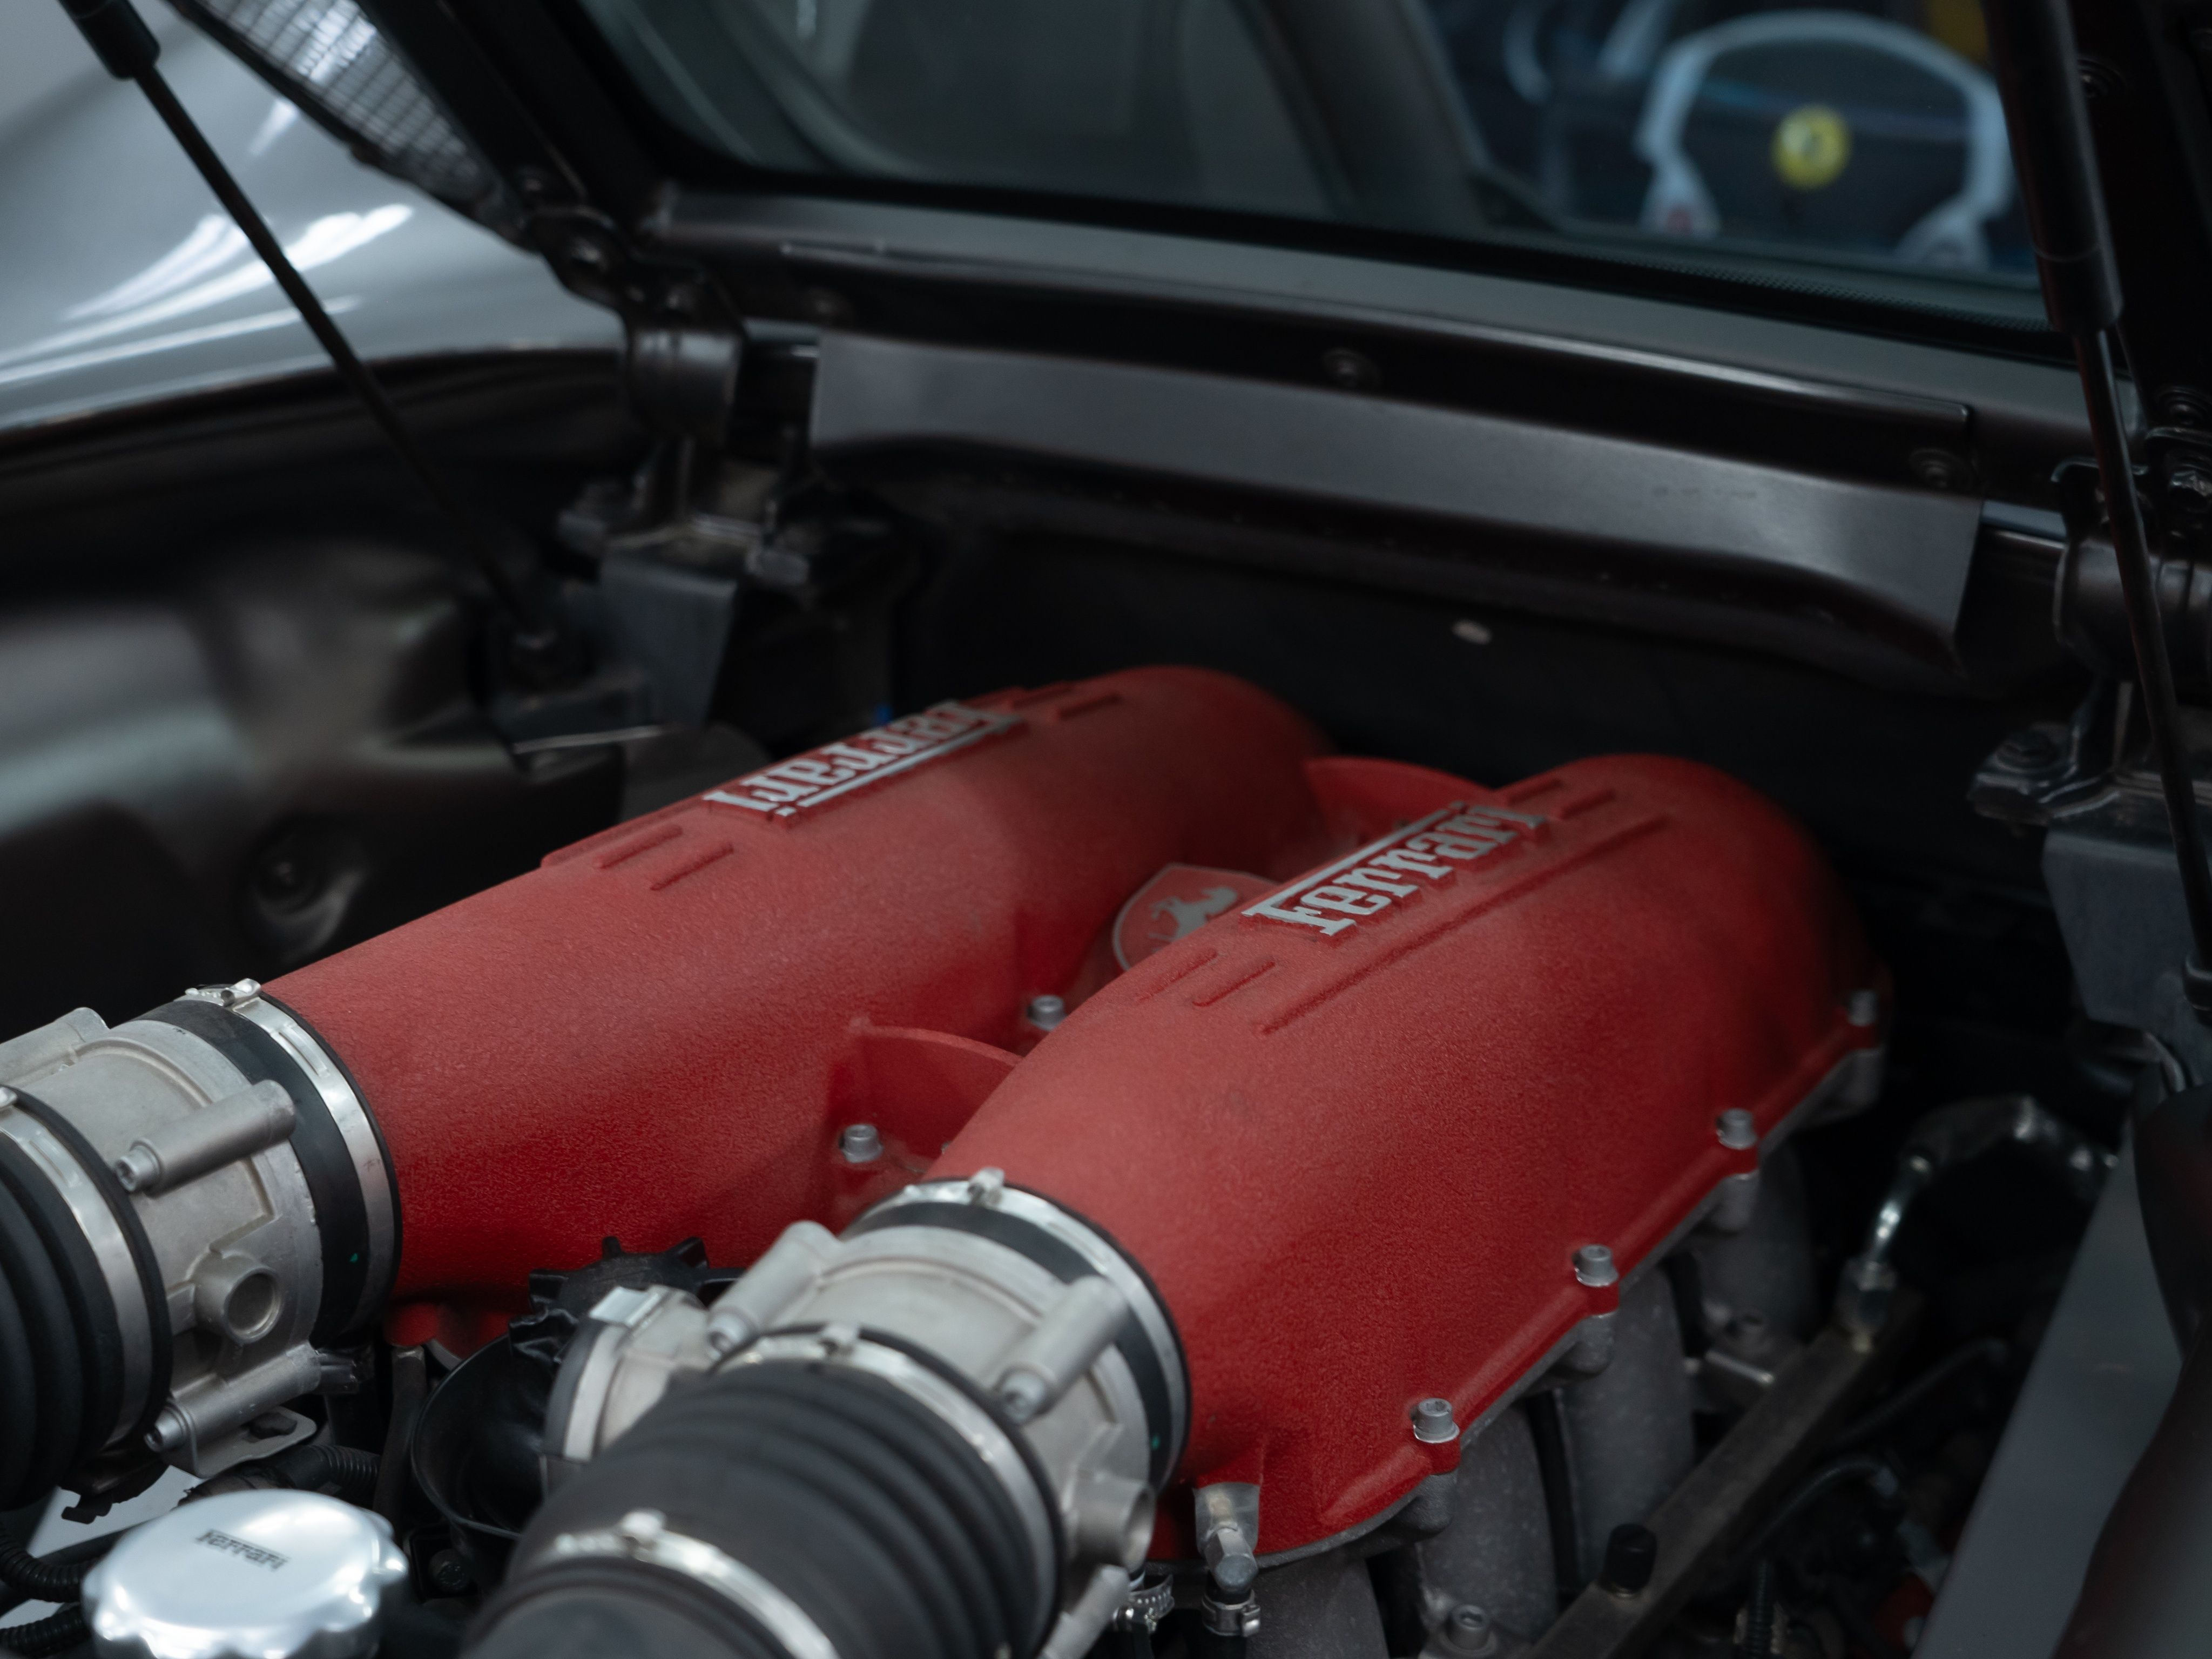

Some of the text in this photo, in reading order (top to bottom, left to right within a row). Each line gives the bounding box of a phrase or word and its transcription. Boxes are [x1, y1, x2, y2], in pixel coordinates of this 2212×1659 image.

[703, 700, 1024, 817] Ferrari
[1242, 801, 1545, 936] Ferrari
[195, 1529, 291, 1570] Ferrari
